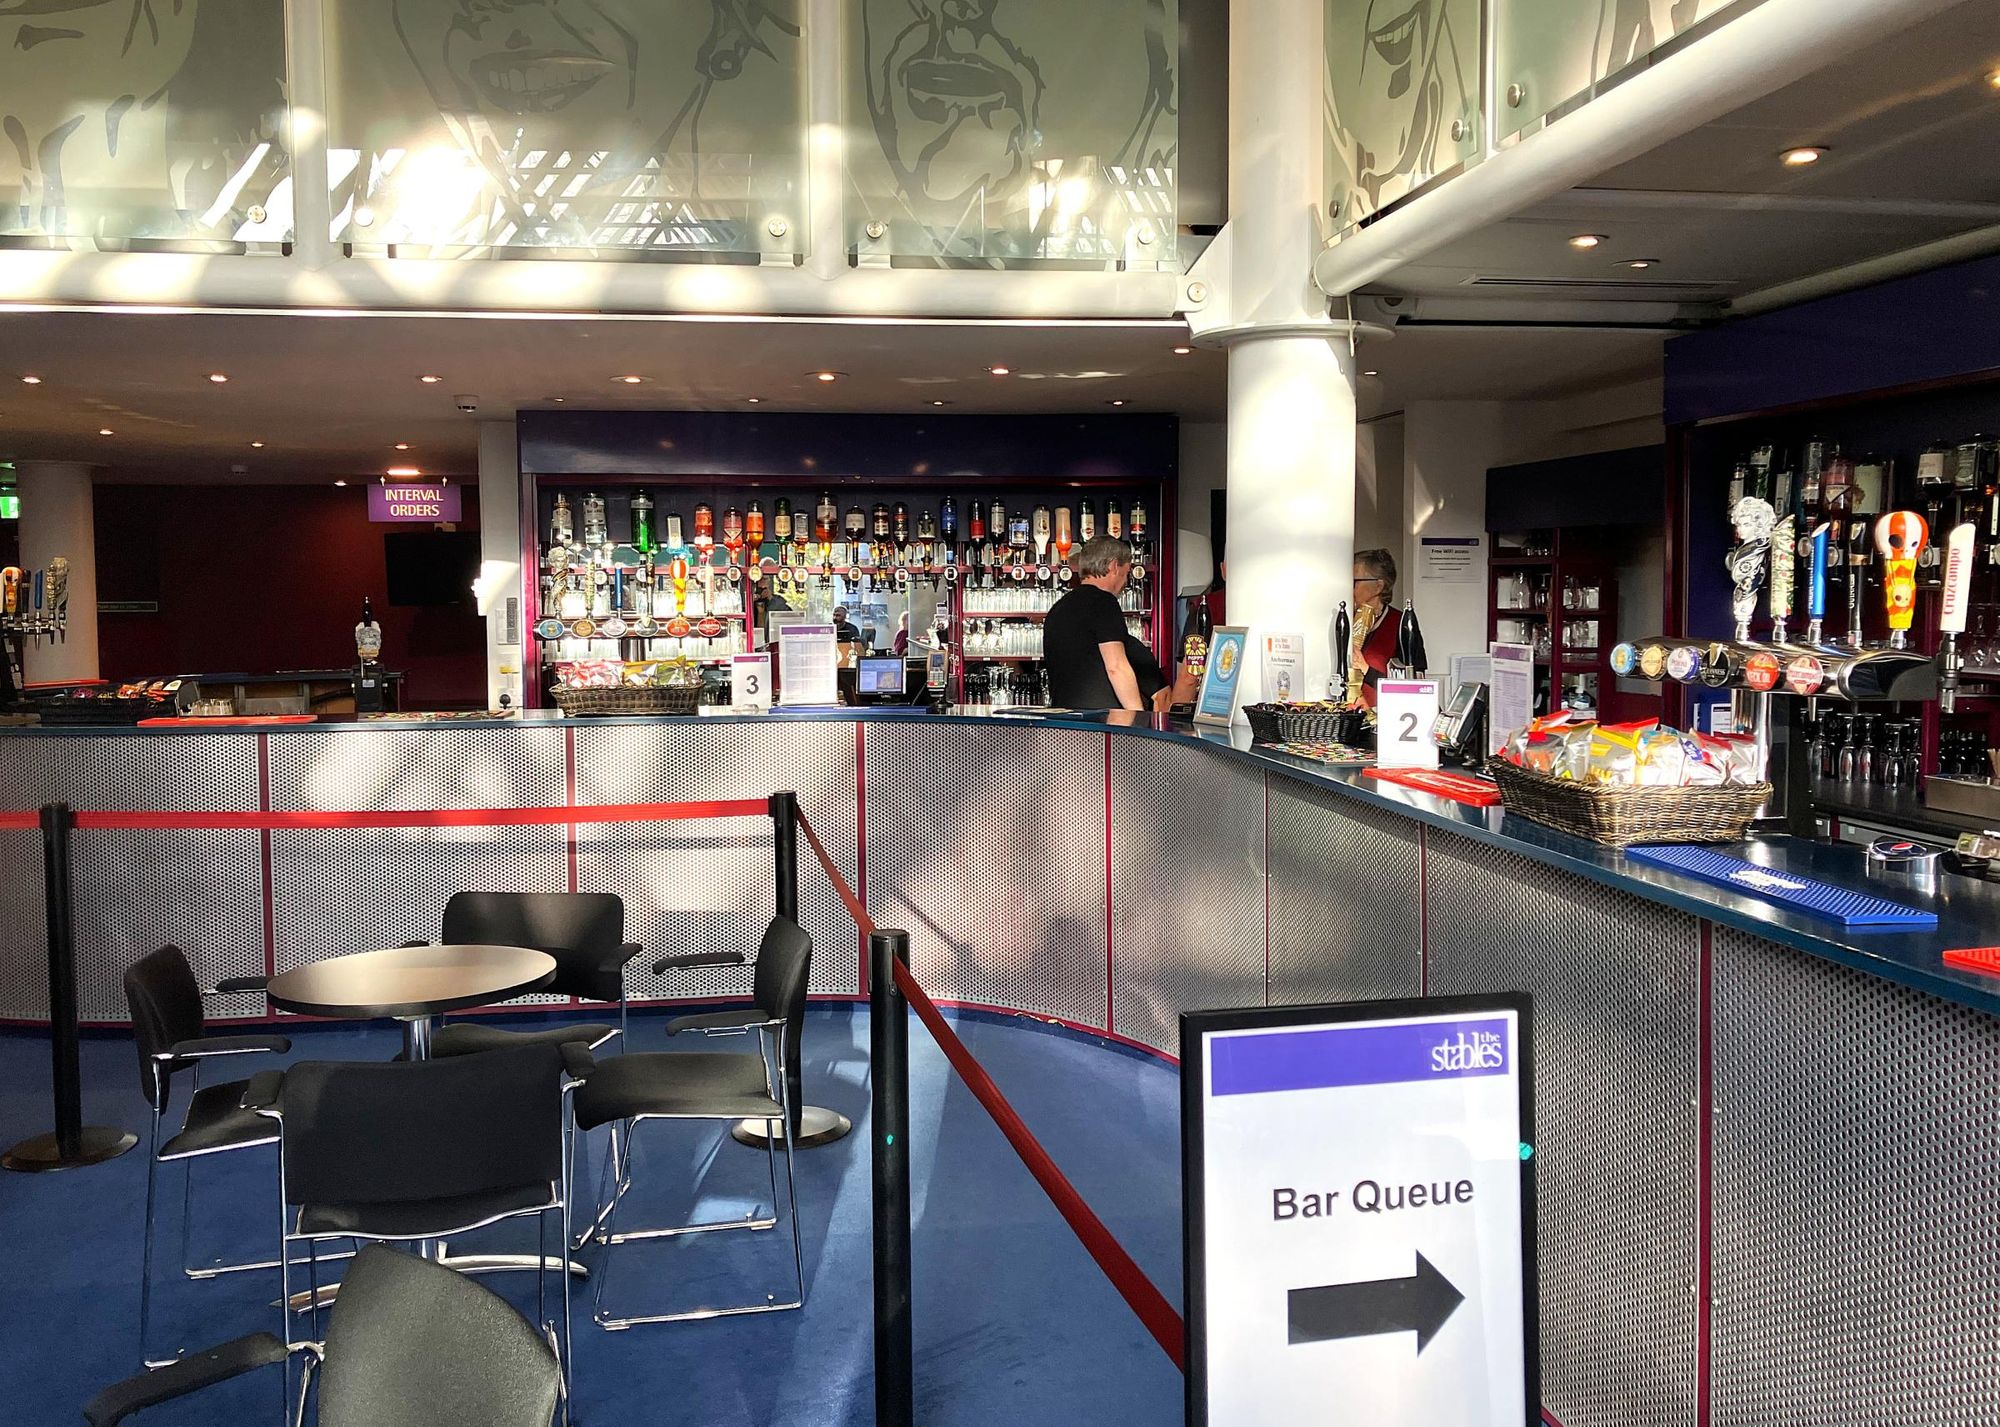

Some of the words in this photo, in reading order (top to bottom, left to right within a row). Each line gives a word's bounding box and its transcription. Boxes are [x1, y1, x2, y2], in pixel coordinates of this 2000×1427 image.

[385, 489, 444, 501] INTERVAL
[390, 504, 440, 517] ORDERS
[1944, 548, 1962, 615] Cruzcampo
[746, 674, 760, 695] 3
[1398, 712, 1418, 742] 2
[1480, 1031, 1501, 1043] the
[1431, 1032, 1503, 1072] stables
[1273, 1187, 1340, 1222] Bar
[1352, 1179, 1474, 1215] Queue
